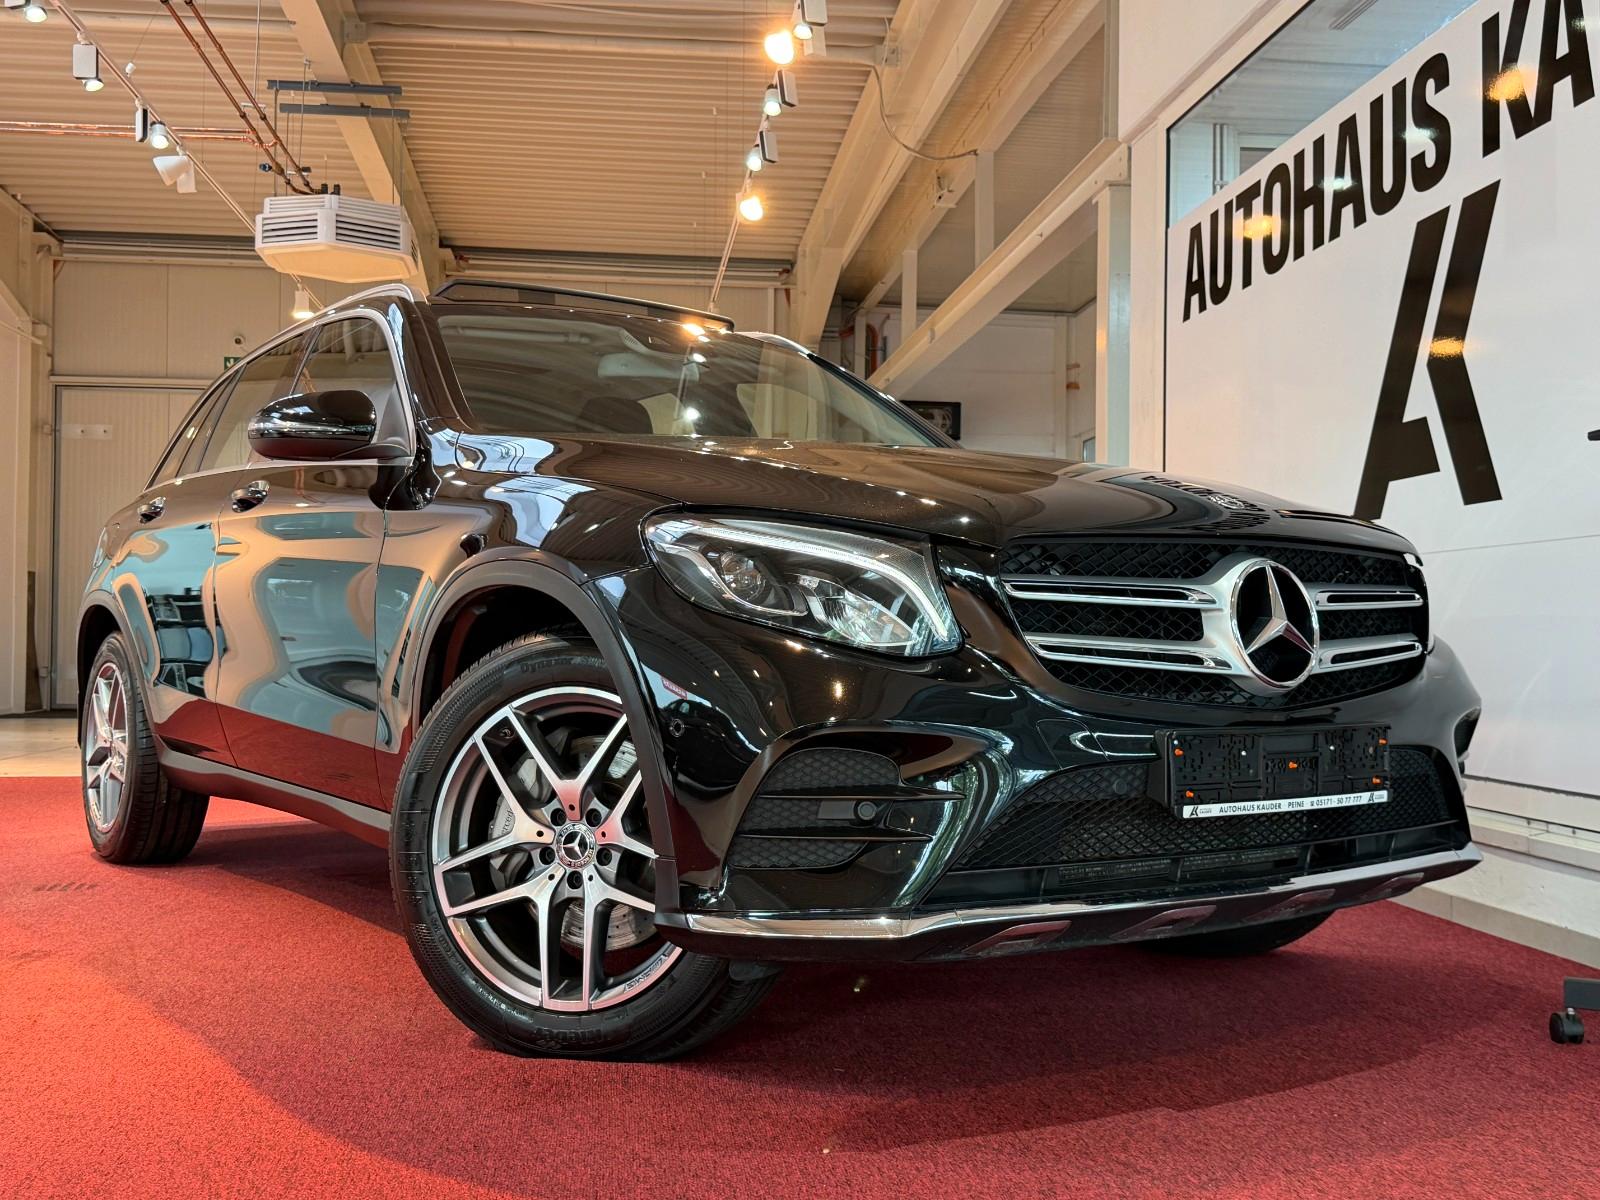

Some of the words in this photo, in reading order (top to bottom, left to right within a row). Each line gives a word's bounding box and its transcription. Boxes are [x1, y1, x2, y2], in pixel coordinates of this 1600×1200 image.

[1182, 53, 1451, 323] AUTOHAUS
[1219, 804, 1256, 814] AUTOHAUS
[1256, 802, 1282, 811] KAUDER
[1287, 800, 1305, 809] PEINE
[1316, 798, 1333, 807] 05171
